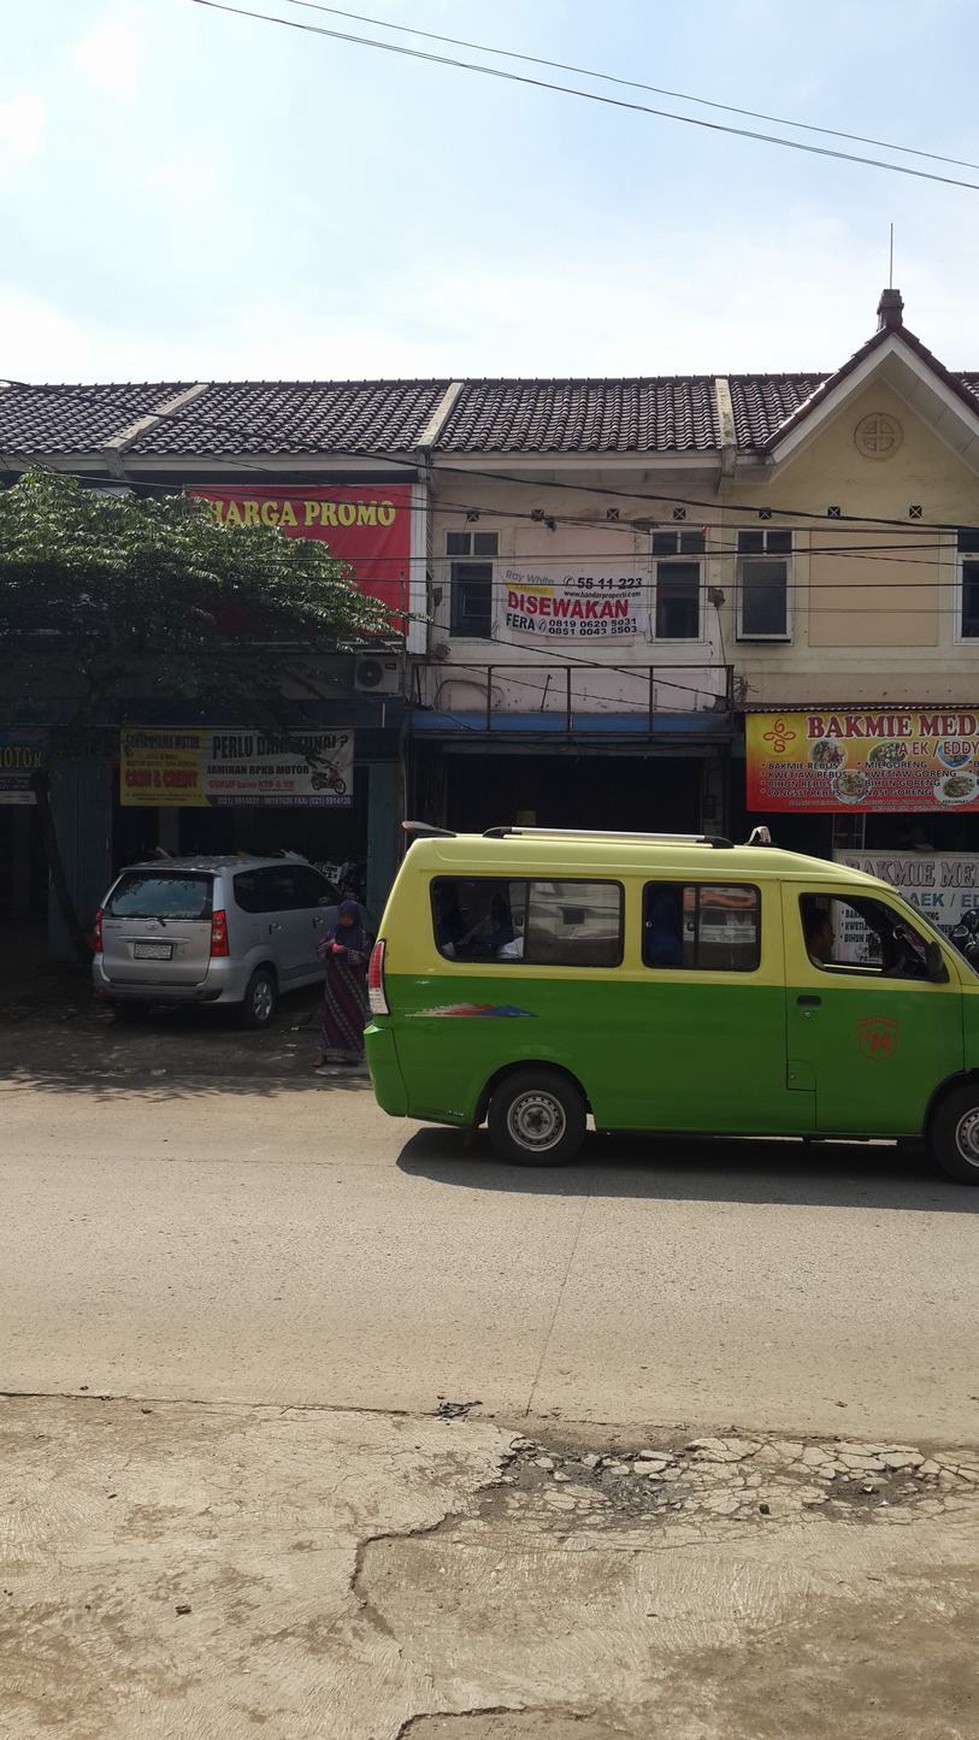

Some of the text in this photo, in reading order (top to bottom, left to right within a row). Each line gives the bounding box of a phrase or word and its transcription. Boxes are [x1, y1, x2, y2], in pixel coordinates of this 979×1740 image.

[303, 500, 396, 527] PROMO
[577, 577, 642, 590] 55 11 223
[507, 590, 629, 619] DISEWAKAN
[506, 612, 536, 631] FERA
[549, 618, 637, 628] 0819 0620 5031
[549, 625, 638, 636] 0851 0043 5503
[807, 713, 979, 739] BAKMIE MED
[213, 735, 254, 760] PERLU
[0, 746, 42, 769] OTOR
[276, 765, 310, 775] MOTOR
[807, 762, 839, 770] REBUS
[886, 761, 927, 769] GORENG
[914, 770, 957, 778] GORENG
[899, 779, 941, 787] GORENG
[940, 861, 979, 888] ME
[909, 892, 944, 907] AEK
